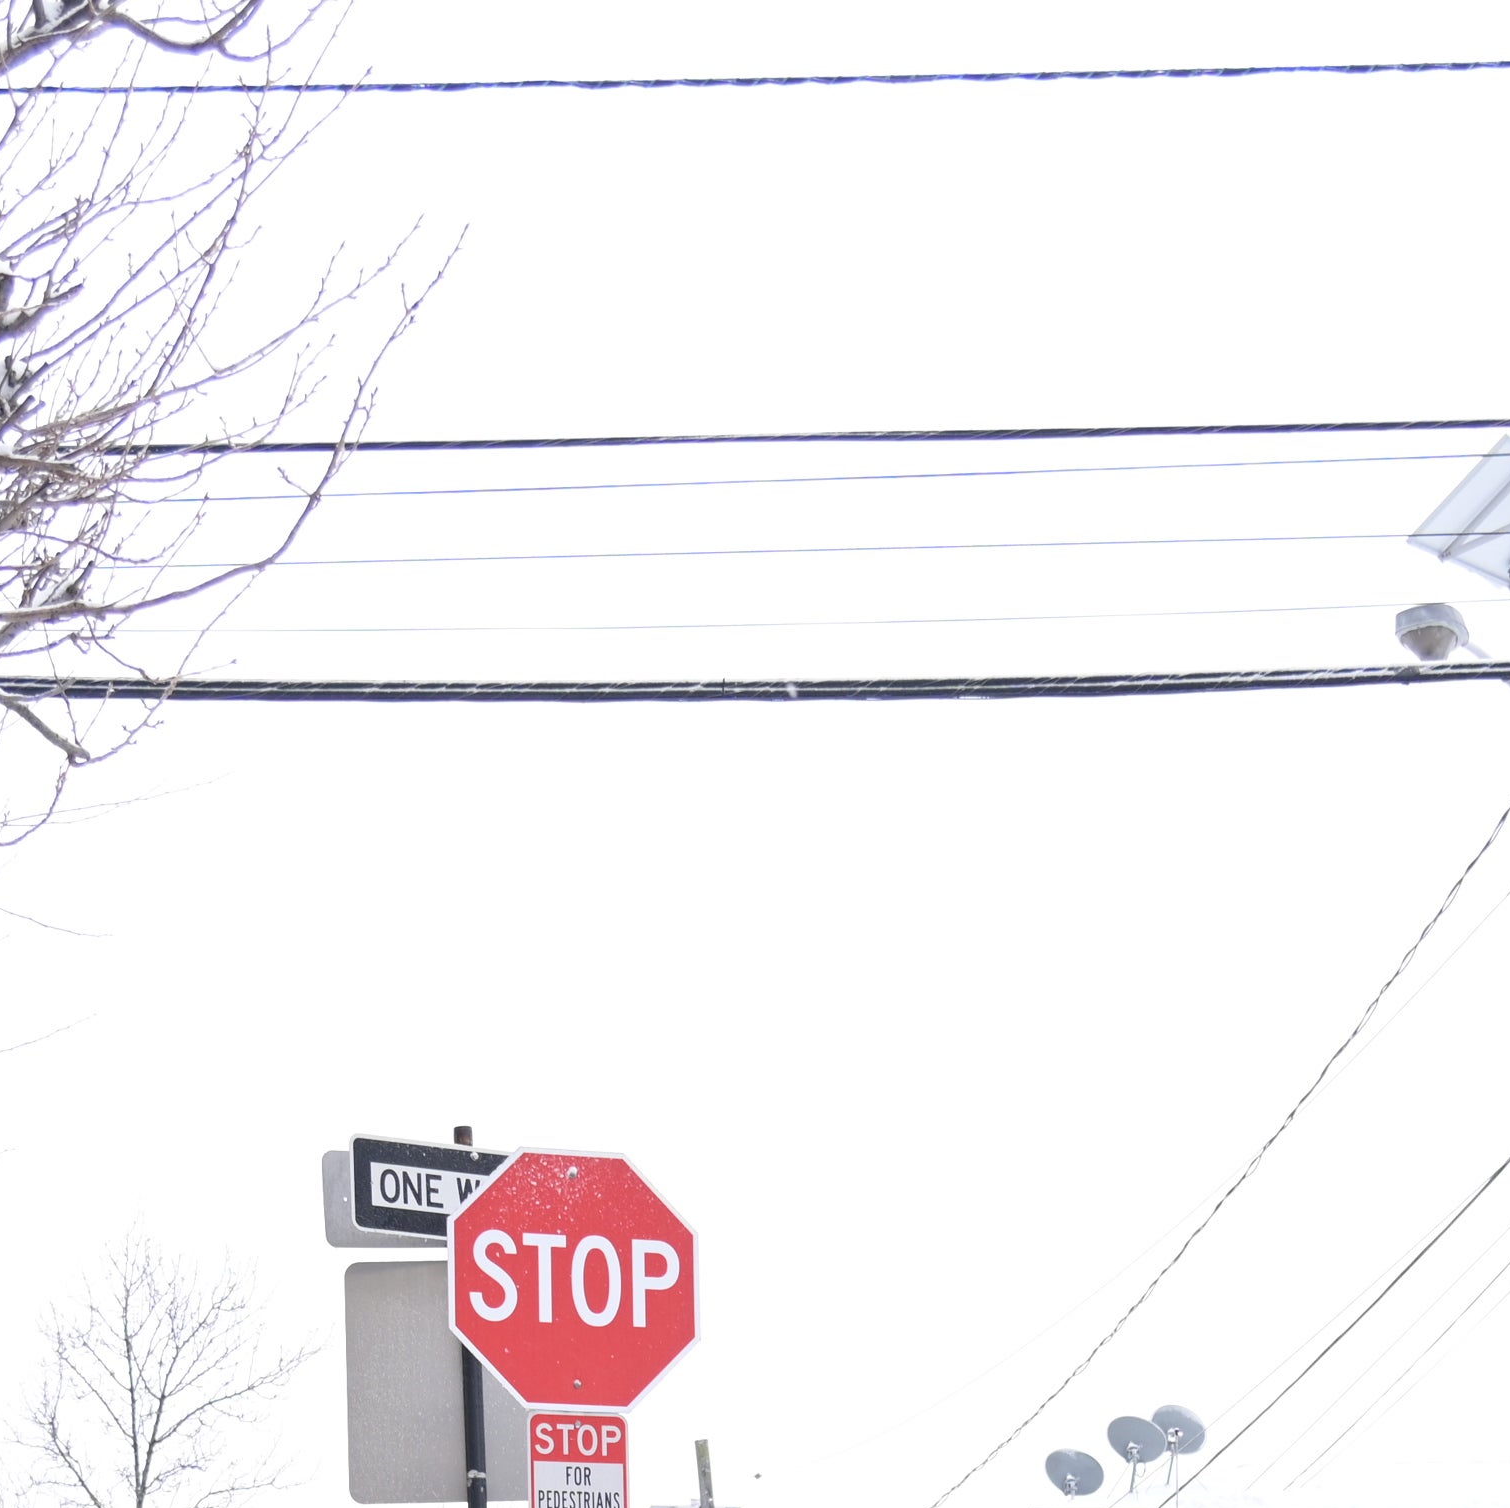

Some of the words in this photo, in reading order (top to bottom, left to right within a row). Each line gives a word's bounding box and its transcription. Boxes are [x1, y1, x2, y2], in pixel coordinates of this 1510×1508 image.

[380, 1169, 444, 1209] ONE
[469, 1229, 681, 1328] STOP
[534, 1422, 622, 1457] STOP
[565, 1466, 592, 1486] FOR
